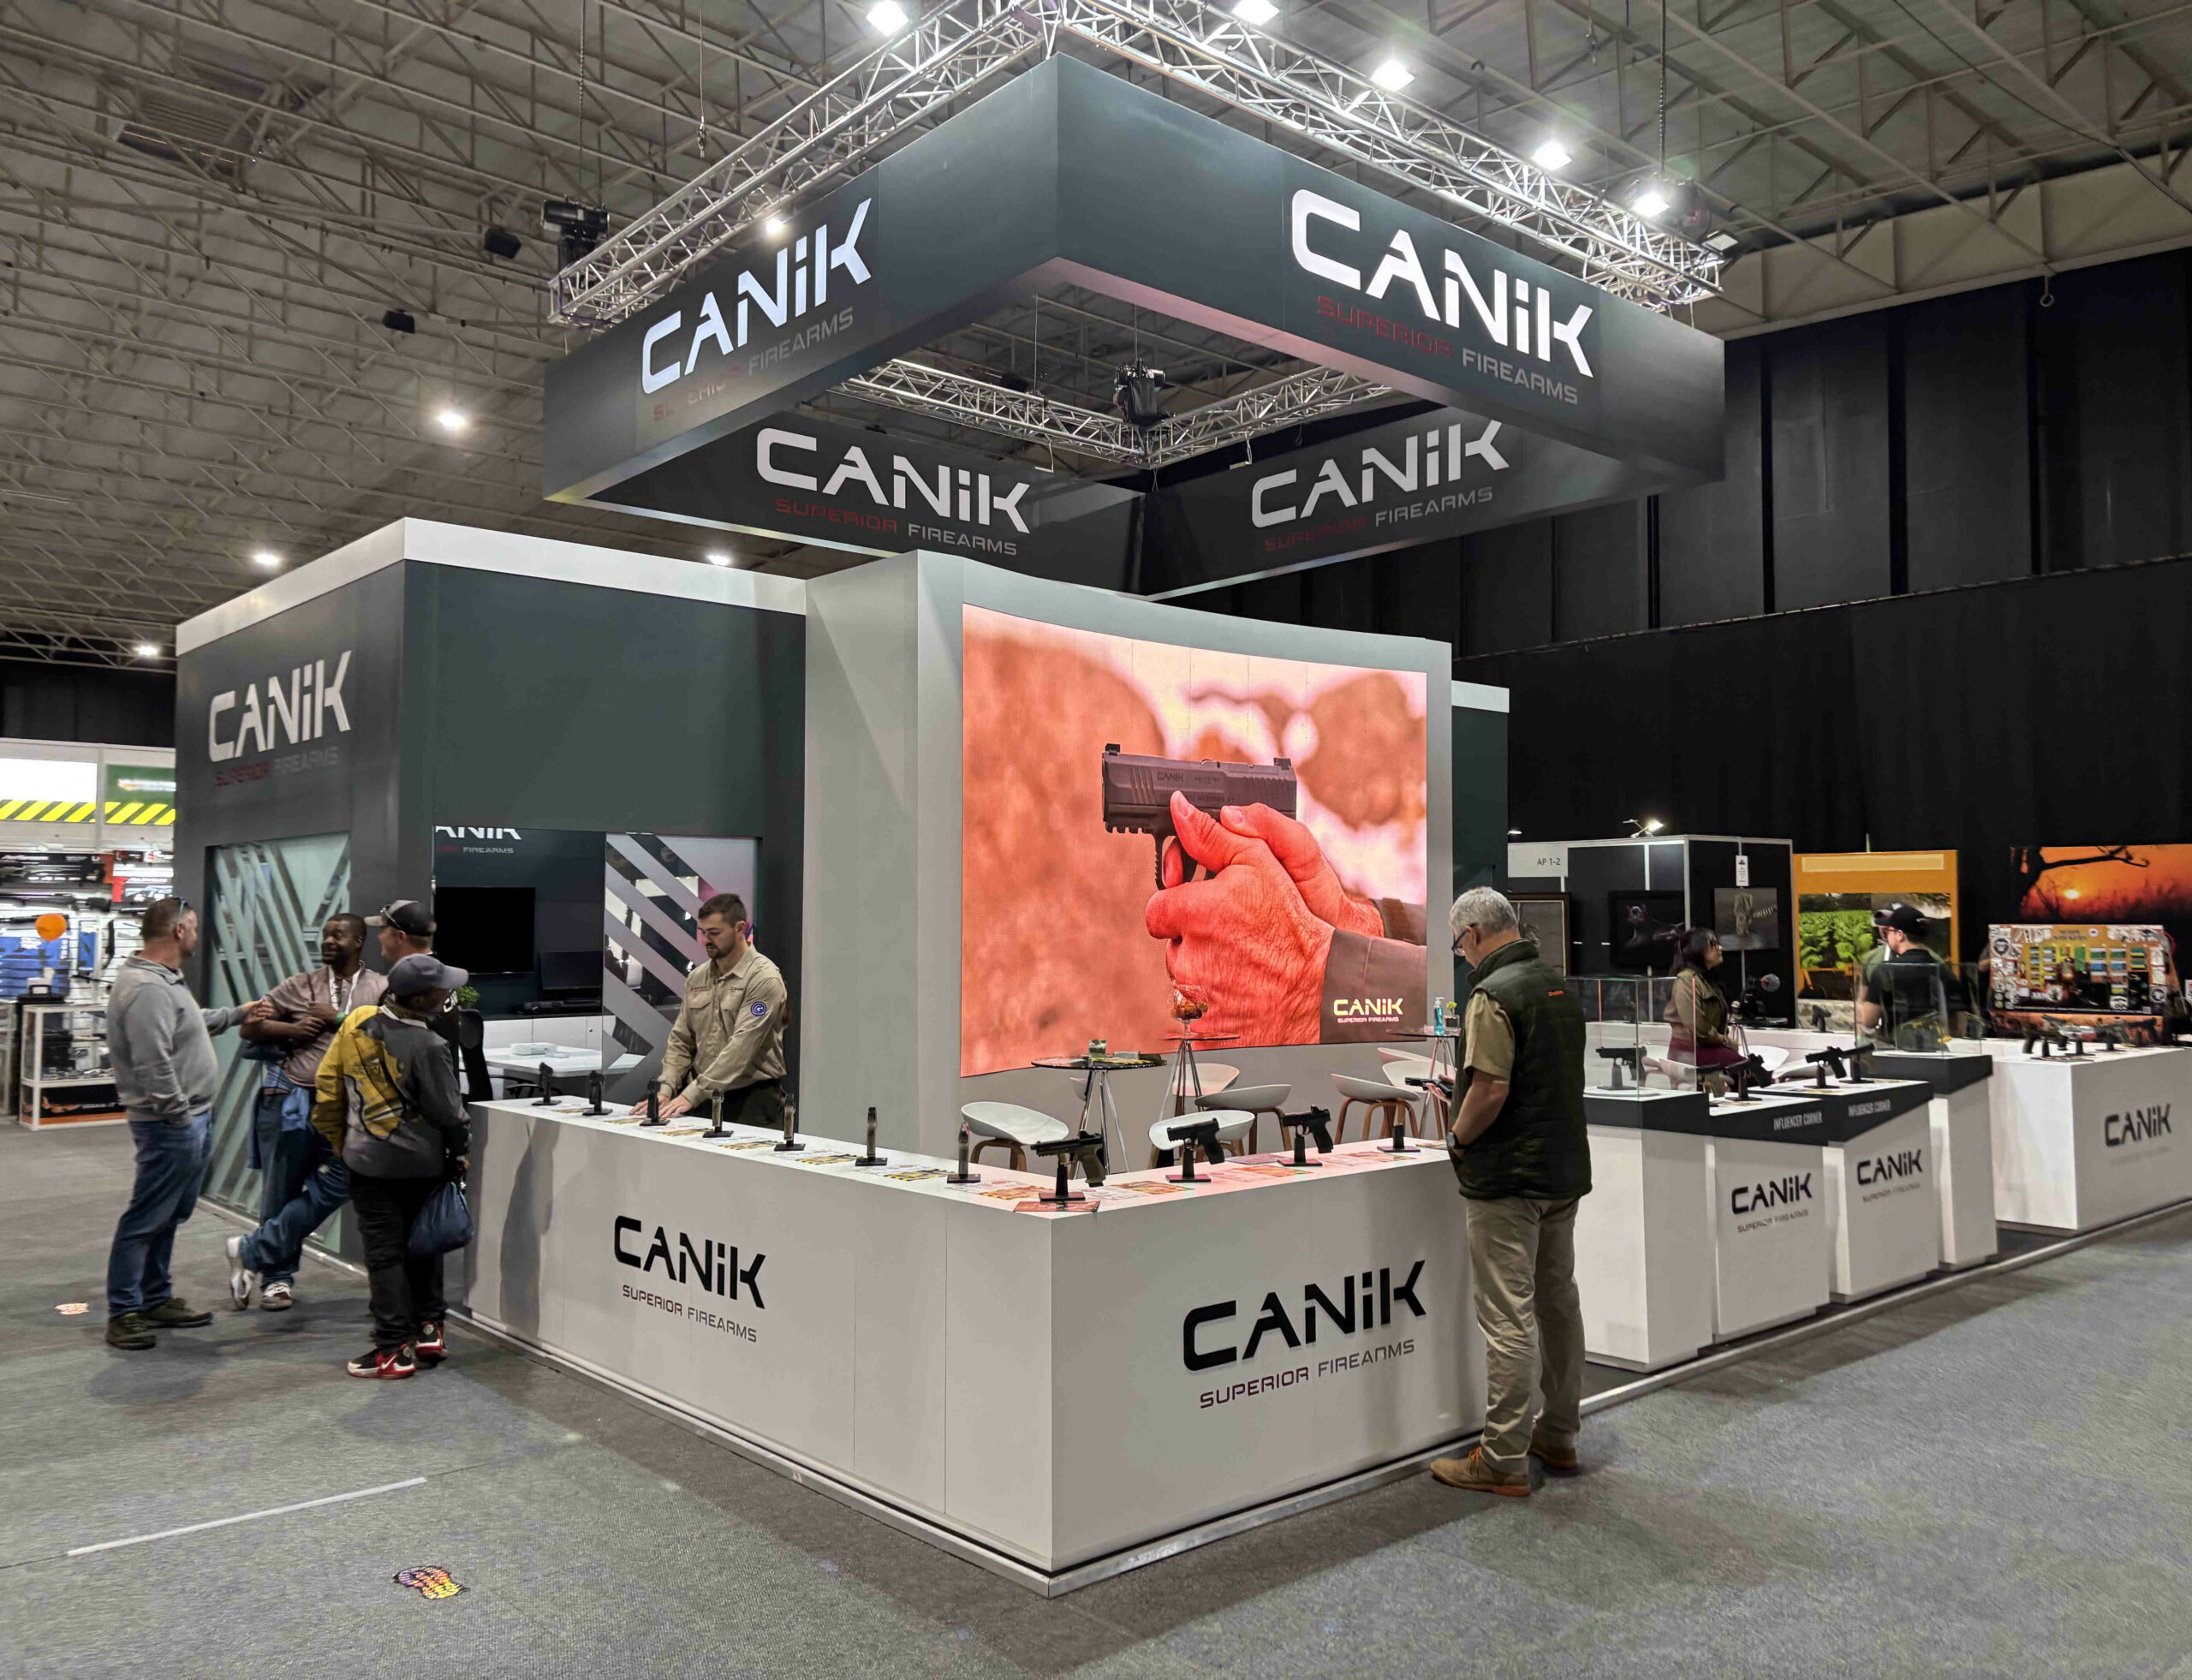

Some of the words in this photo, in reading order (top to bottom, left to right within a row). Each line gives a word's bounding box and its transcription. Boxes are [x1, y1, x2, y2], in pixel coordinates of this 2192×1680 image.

[748, 307, 854, 377] FIREARMS
[1317, 295, 1452, 360] SUPERIOR
[1462, 347, 1578, 405] FIREARMS
[775, 497, 897, 534] SUPERIOR
[908, 522, 1017, 556] FIREARMS
[1264, 515, 1367, 552] SUPERIOR
[1375, 486, 1493, 527] FIREARMS
[462, 846, 515, 855] FIREARMS
[1536, 857, 1547, 867] AP
[1548, 856, 1561, 866] 1-2
[622, 1284, 683, 1316] SUPERIOR
[687, 1306, 758, 1343] FIREARMS
[1200, 1366, 1309, 1409] SUPERIOR
[1318, 1338, 1415, 1378] FIREARMS
